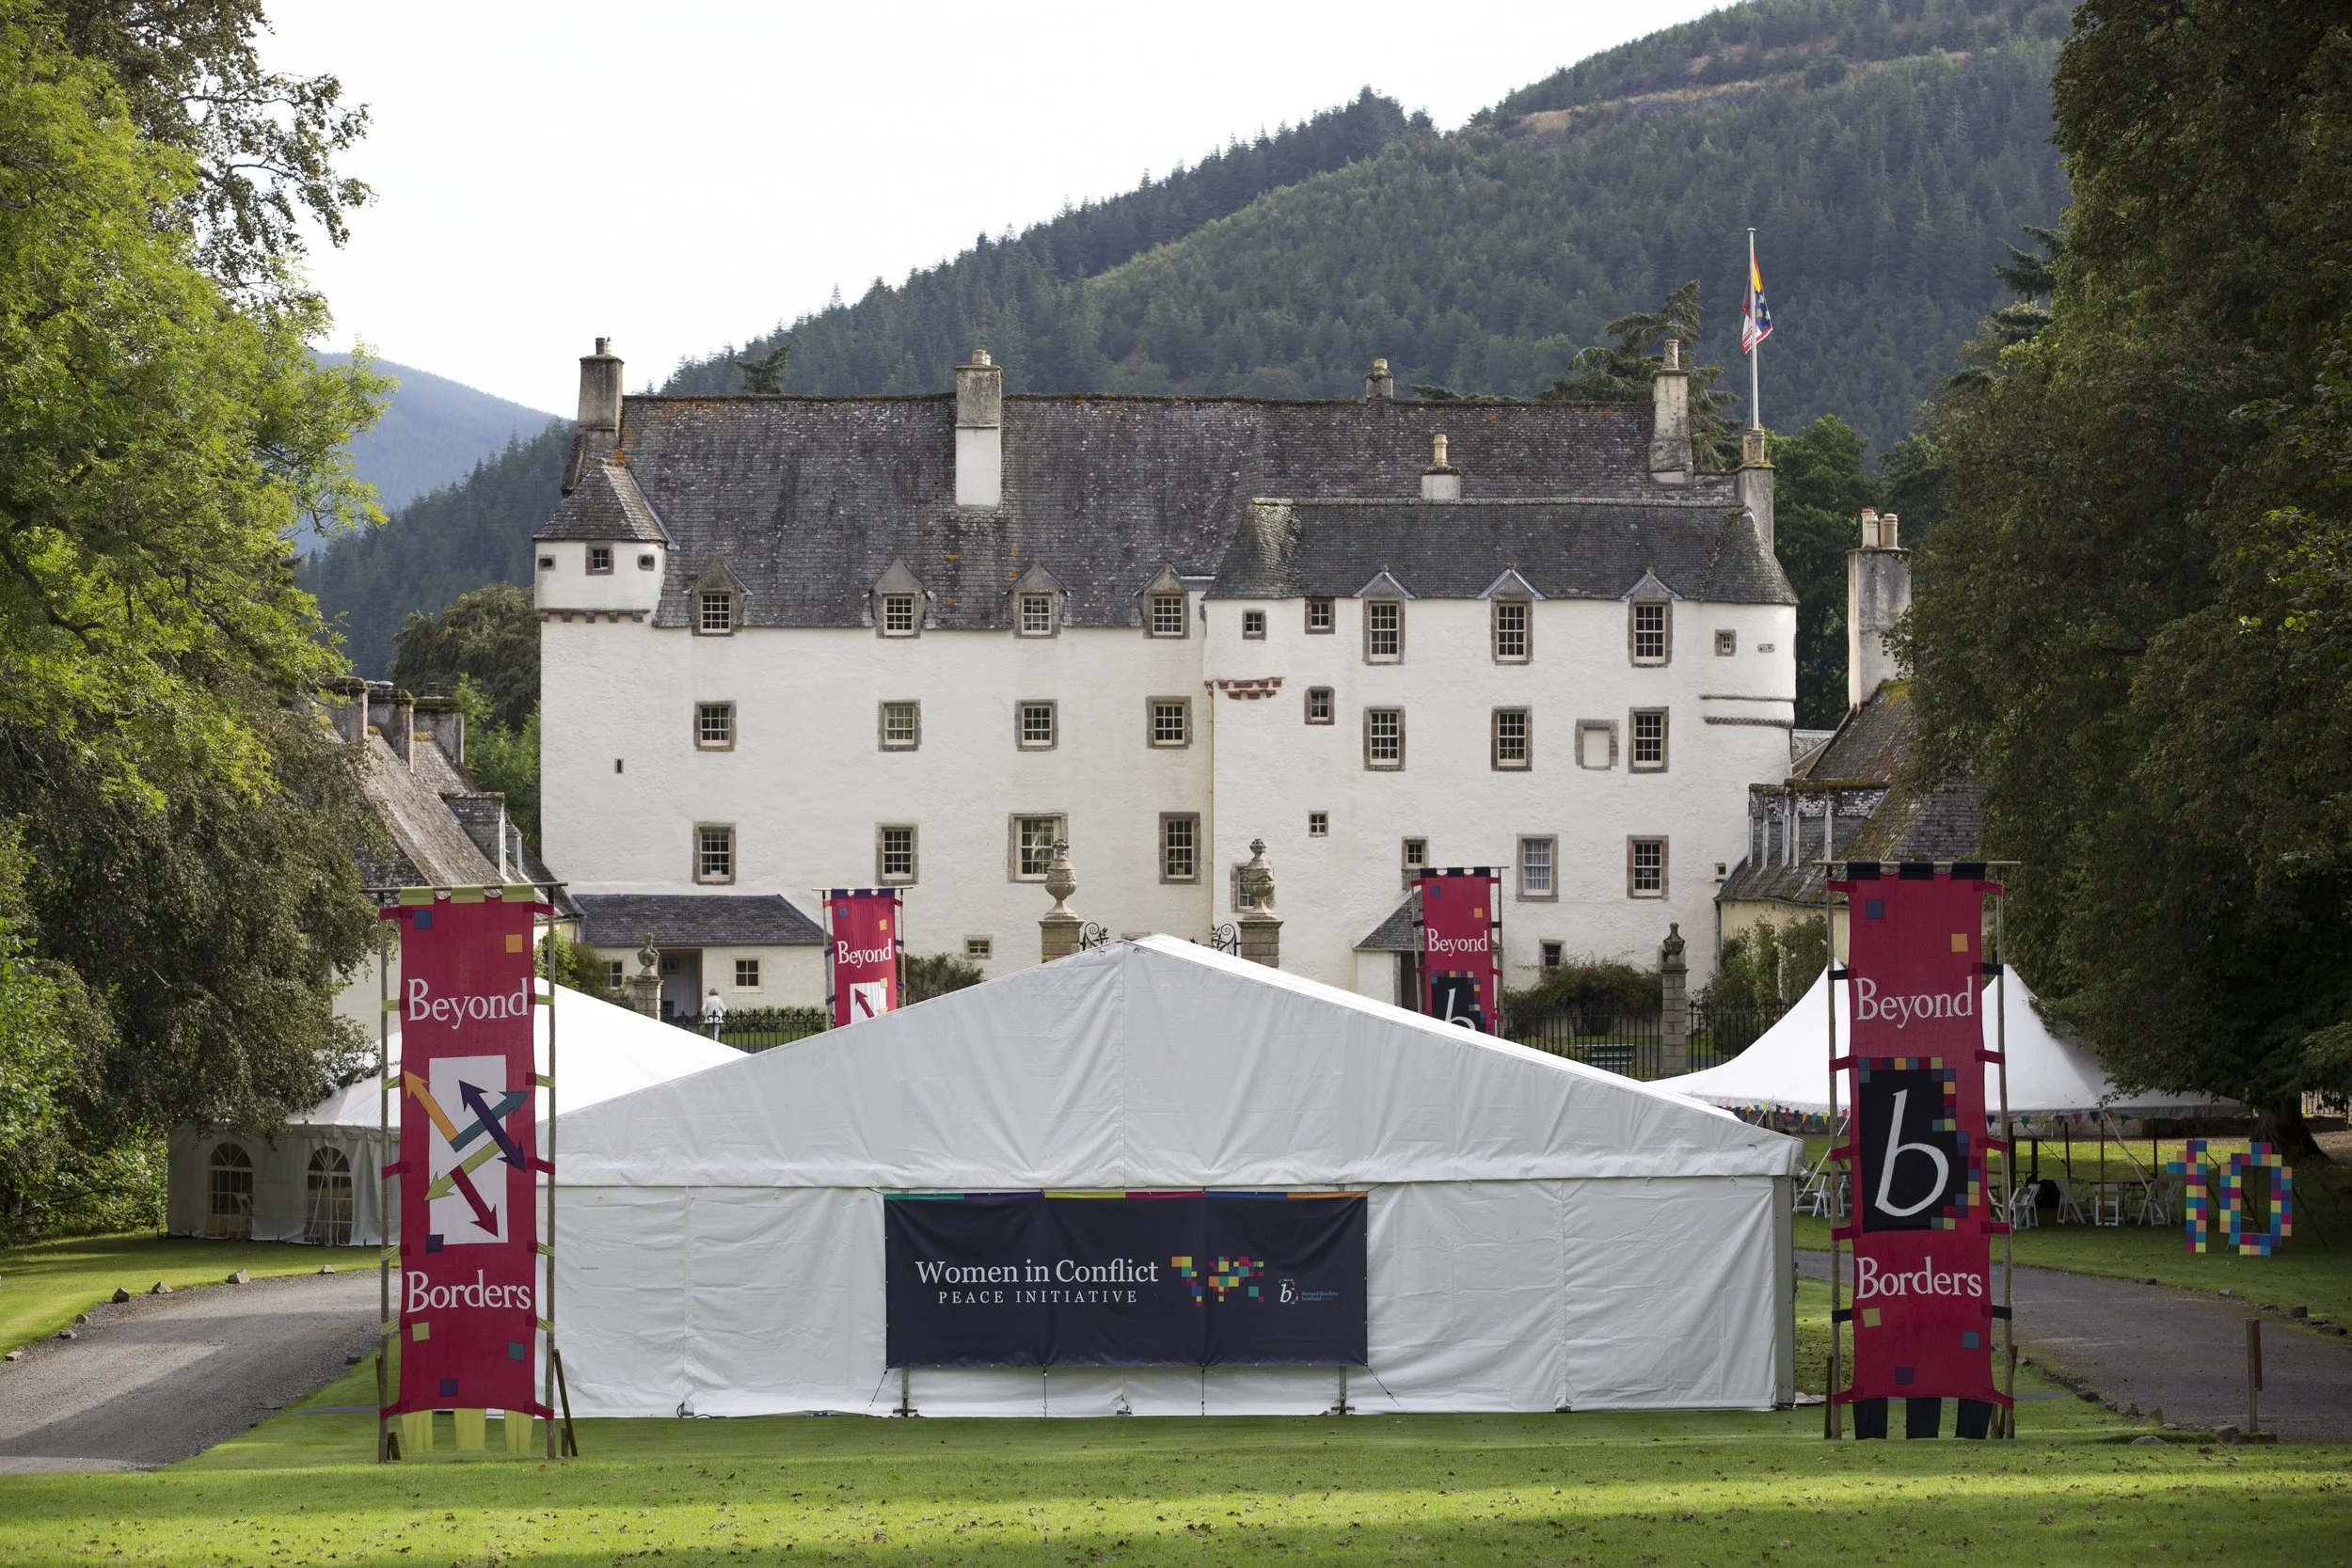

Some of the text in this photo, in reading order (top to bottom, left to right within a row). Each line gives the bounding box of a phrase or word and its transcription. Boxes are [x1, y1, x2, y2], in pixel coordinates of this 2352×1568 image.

[836, 938, 892, 969] Beyond
[1427, 927, 1488, 957] Beyond
[407, 977, 529, 1030] Beyond
[1855, 976, 1973, 1028] Beyond
[1874, 1089, 1950, 1217] b
[2167, 1140, 2292, 1256] 10
[406, 1269, 532, 1314] Borders
[914, 1258, 1159, 1284] Women in Conflict
[1856, 1256, 1982, 1299] Borders
[939, 1290, 1137, 1304] PEACE INITIATIVE
[1279, 1283, 1293, 1304] b
